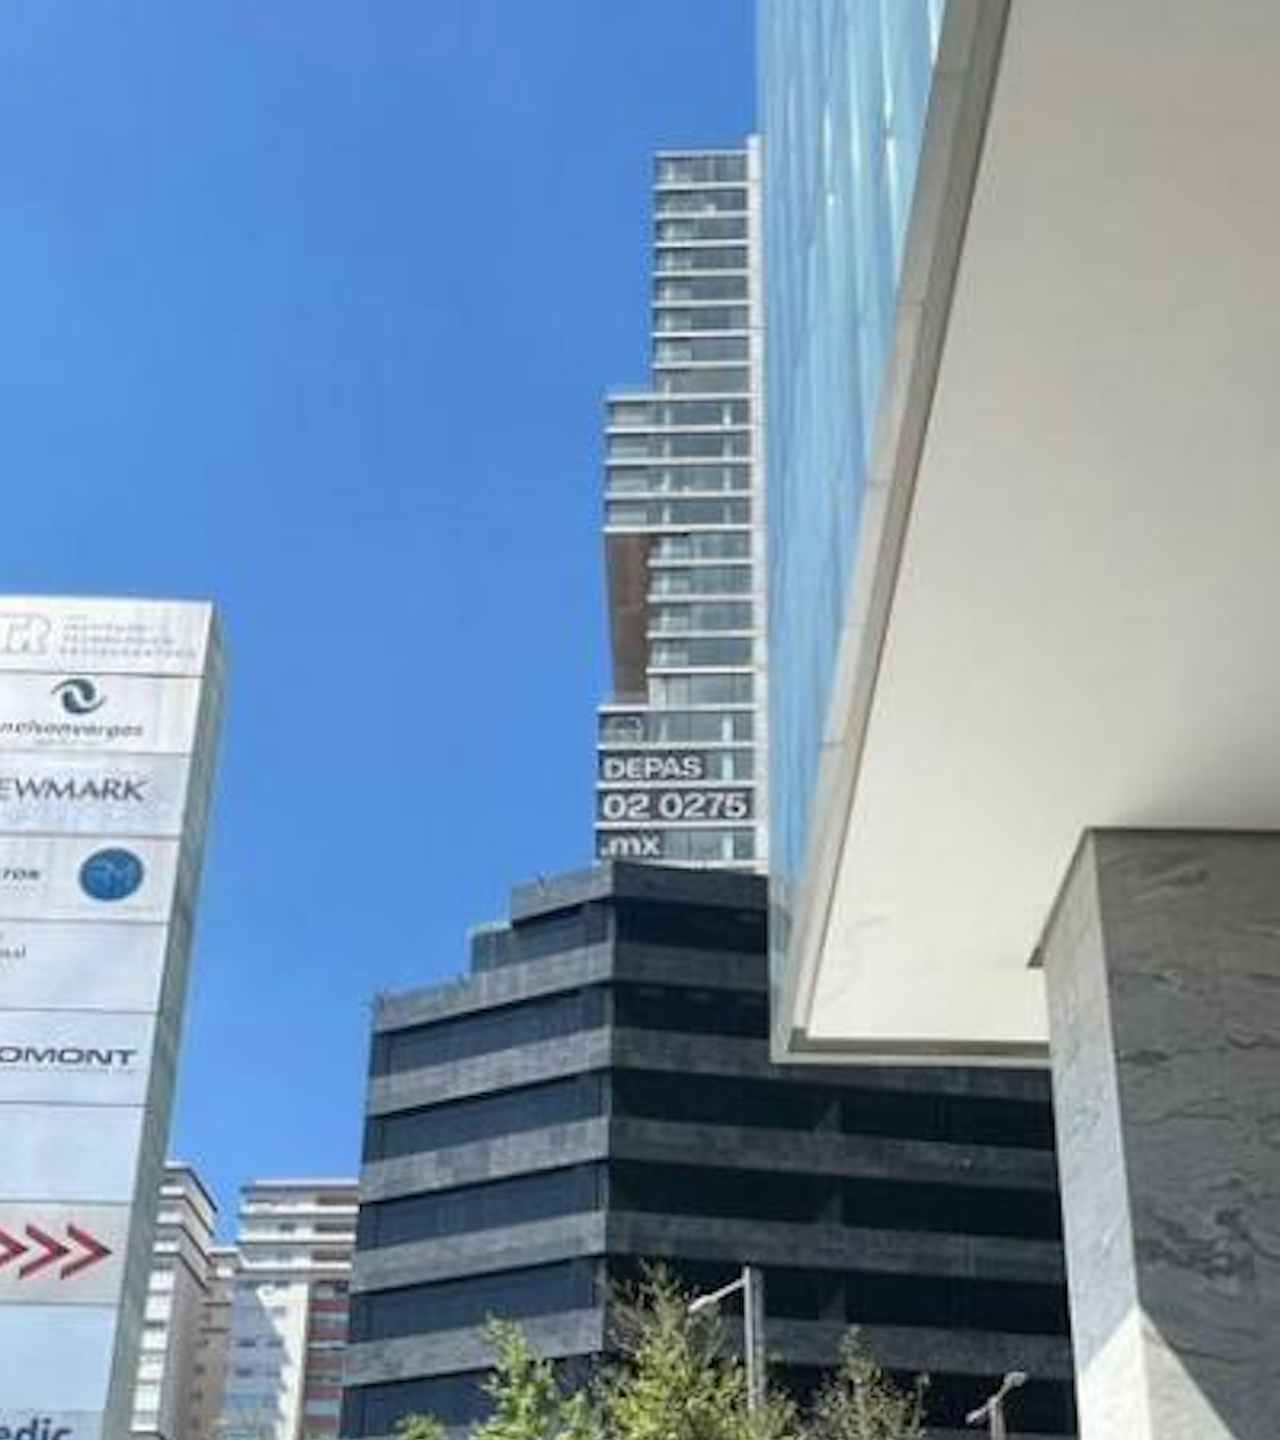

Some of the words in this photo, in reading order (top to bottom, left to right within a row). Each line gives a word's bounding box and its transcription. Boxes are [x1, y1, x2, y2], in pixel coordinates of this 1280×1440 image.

[604, 756, 704, 780] DEPAS
[603, 792, 651, 820] 02
[659, 792, 748, 819] 0275
